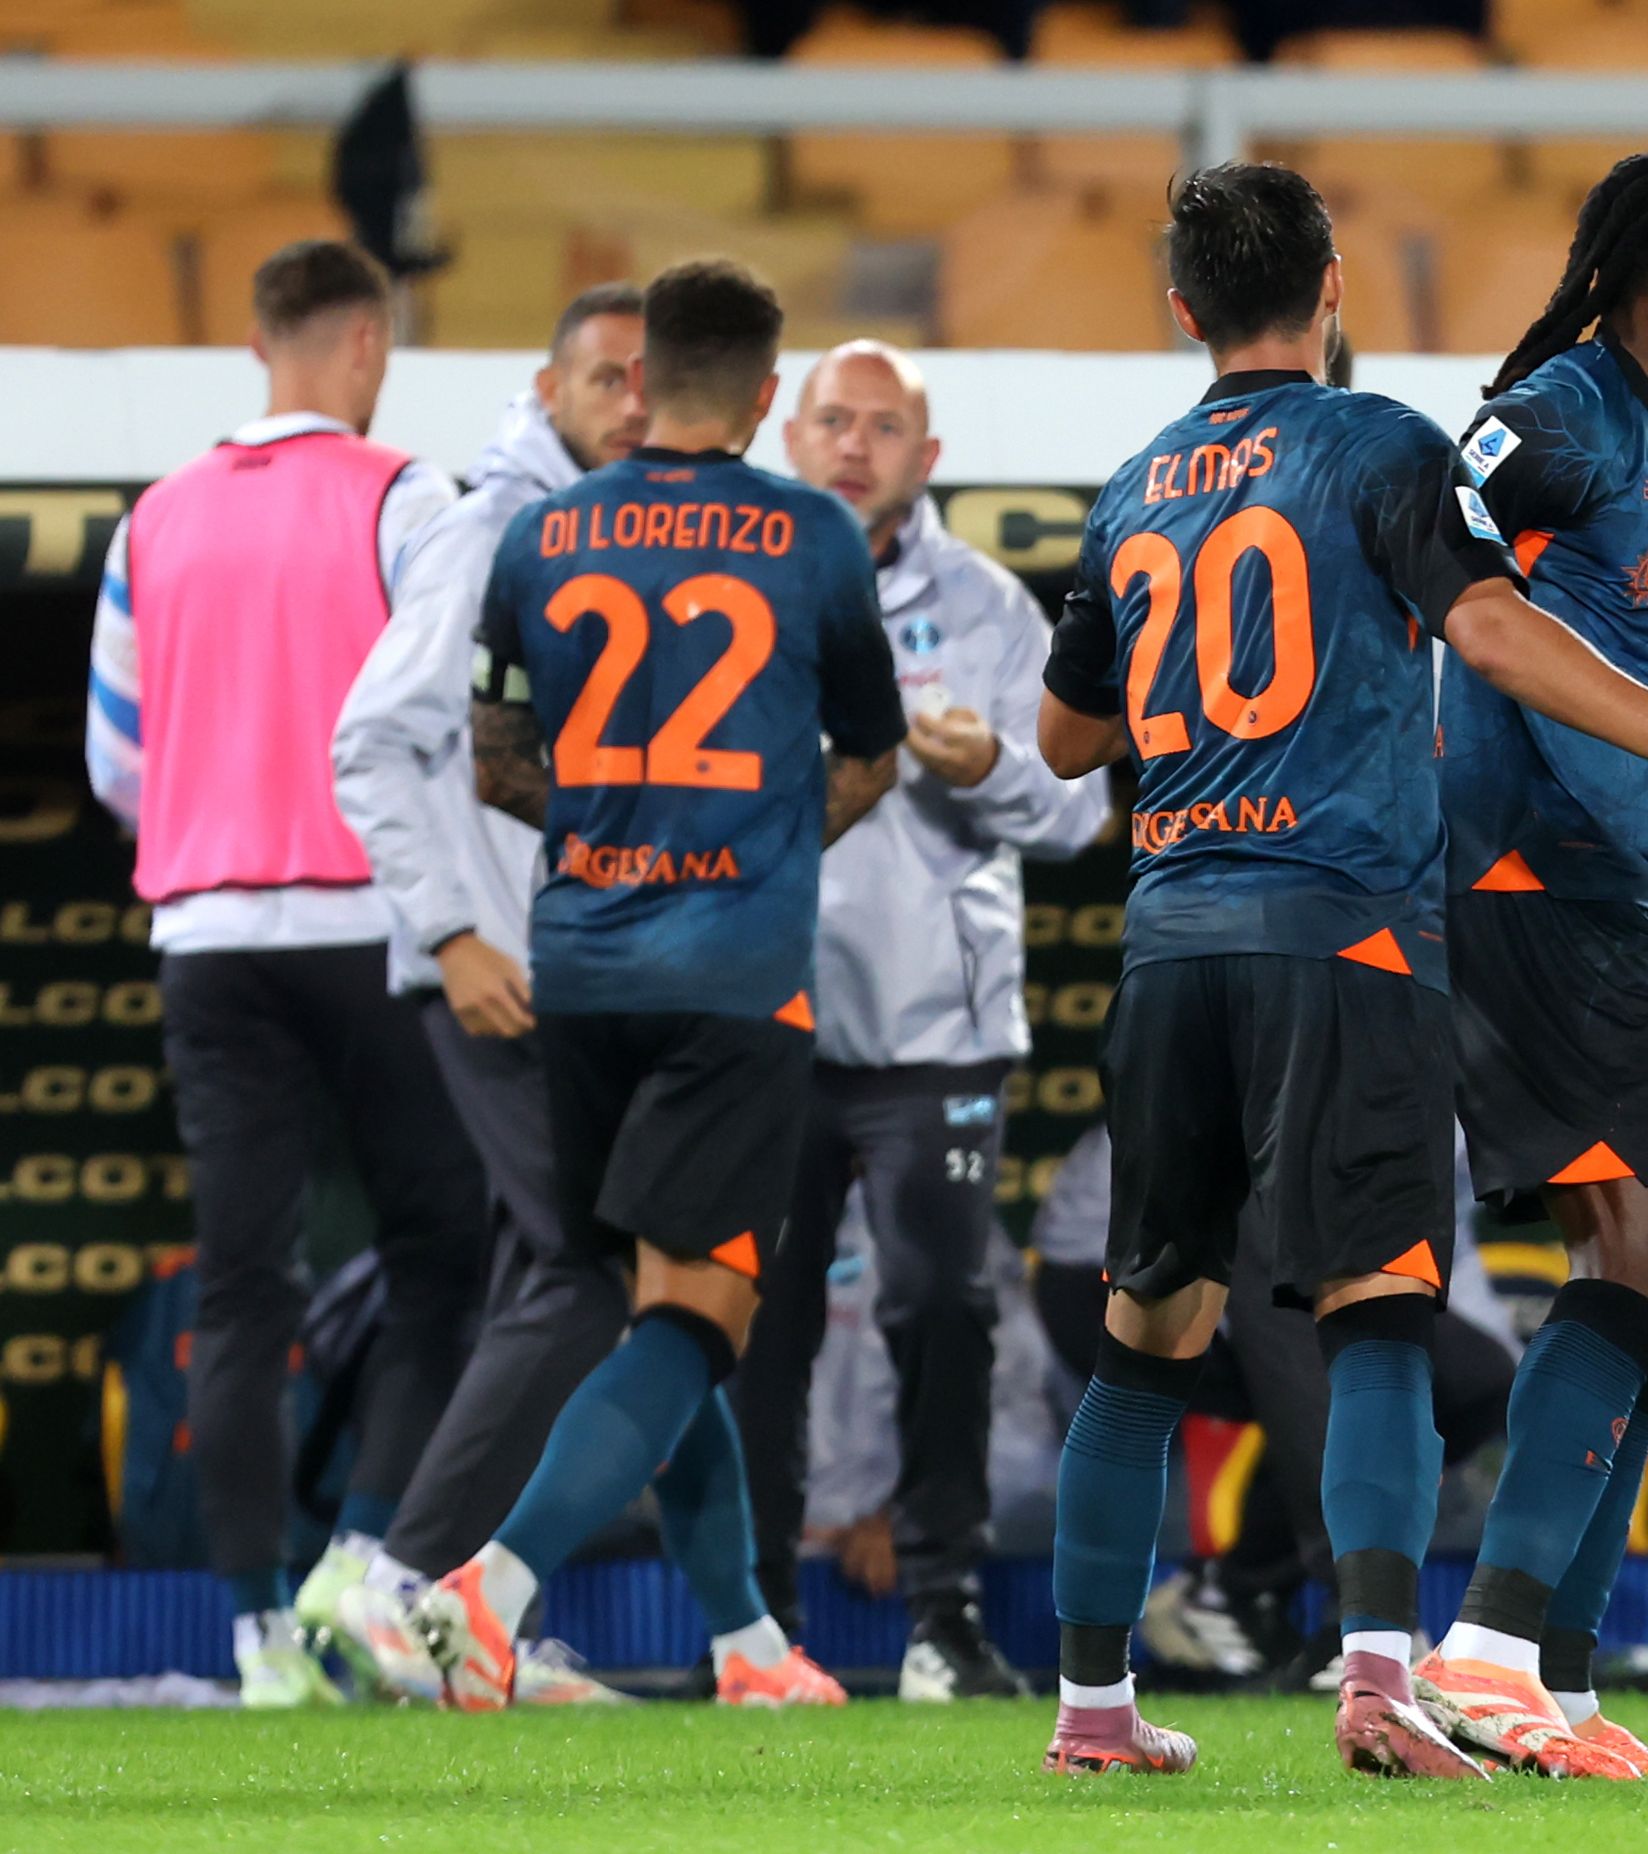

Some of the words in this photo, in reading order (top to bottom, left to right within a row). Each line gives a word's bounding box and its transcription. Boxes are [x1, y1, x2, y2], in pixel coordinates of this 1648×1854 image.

[540, 507, 579, 558] DI
[589, 502, 794, 557] LORENZO
[1145, 427, 1278, 503] ELMAS
[545, 573, 777, 791] 22
[1110, 505, 1316, 760] 20
